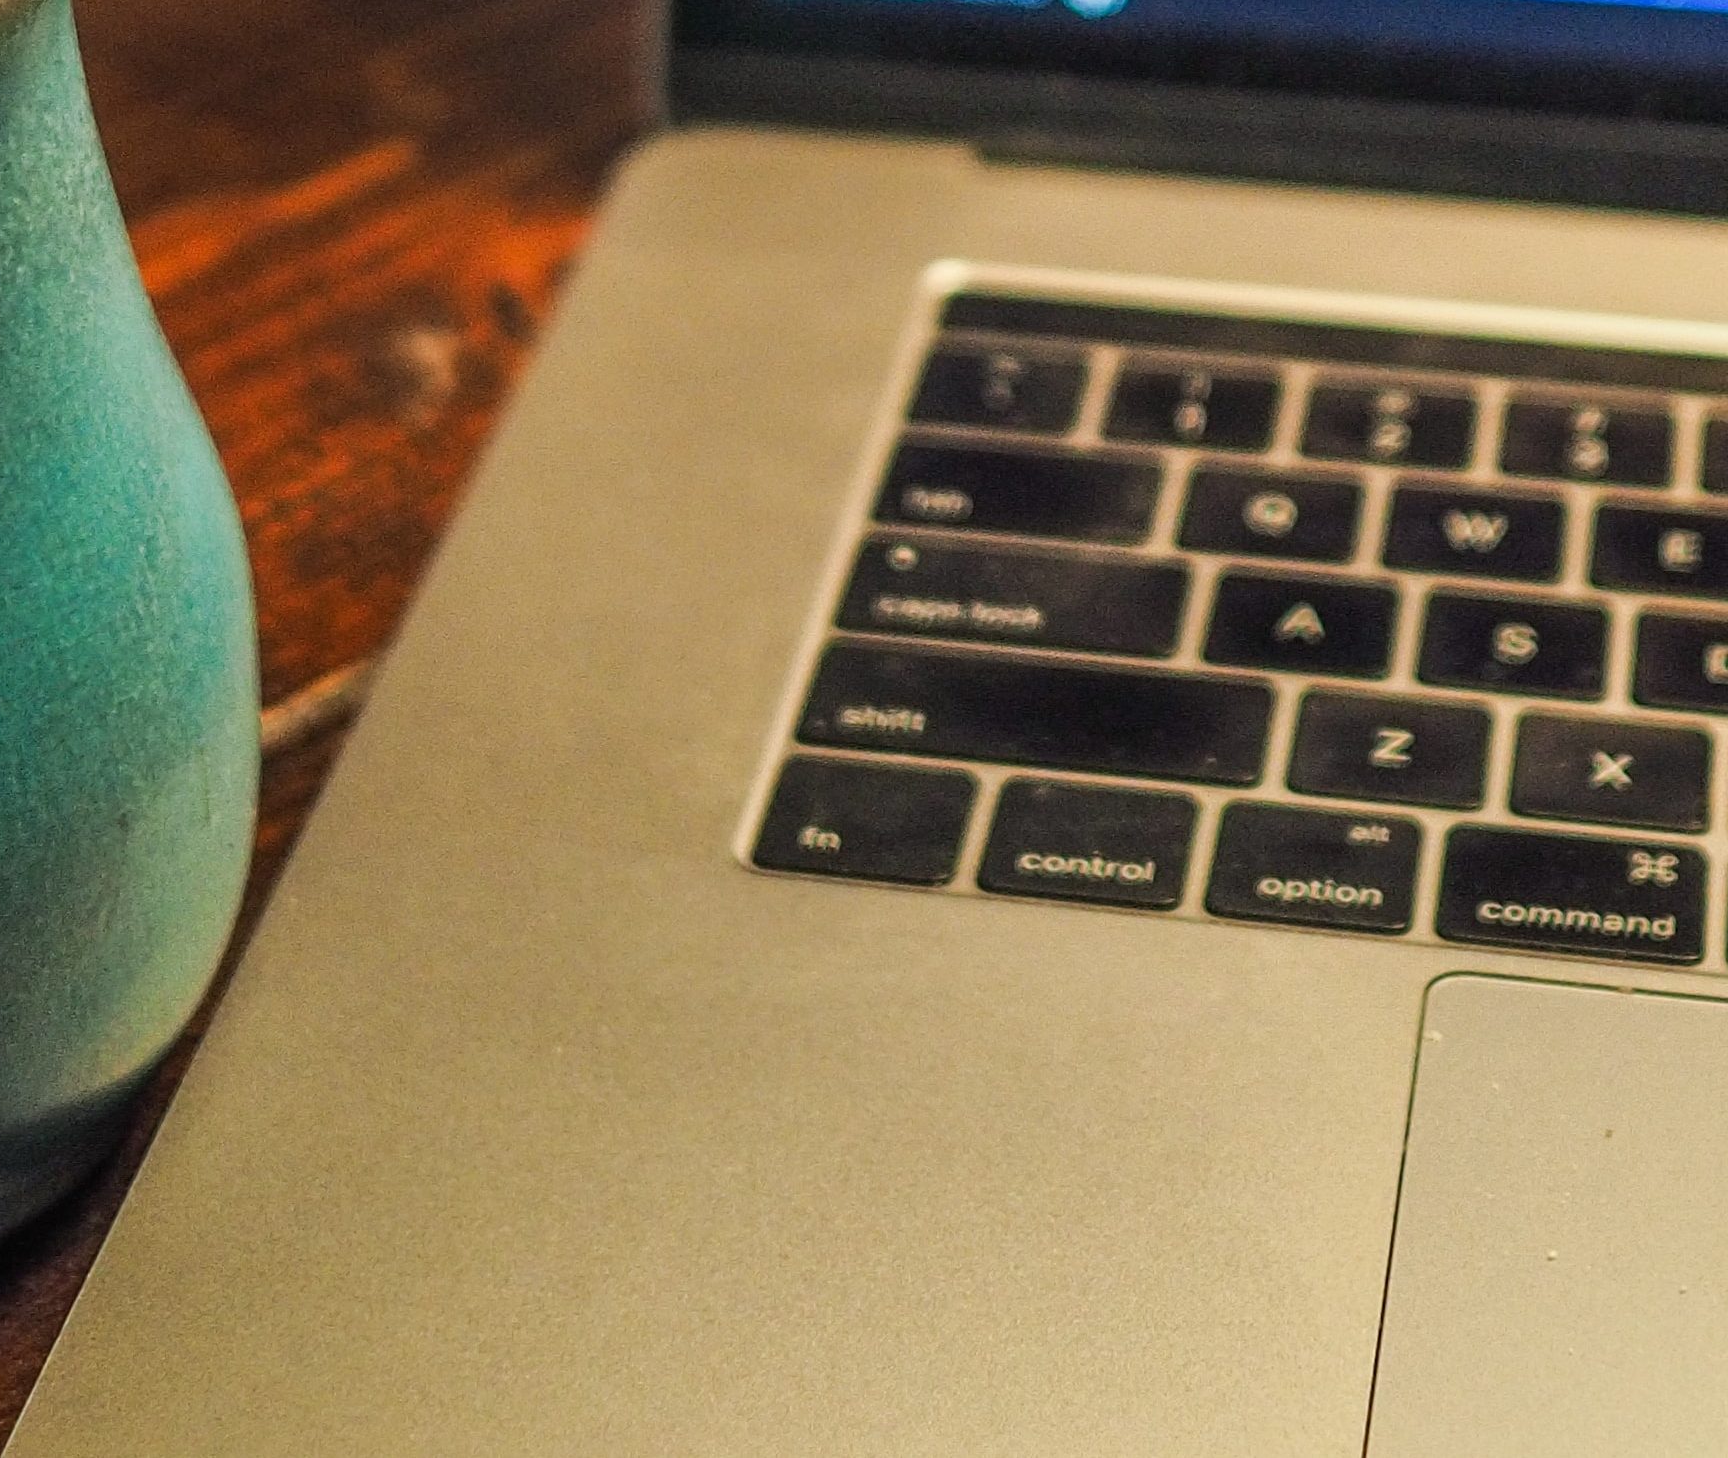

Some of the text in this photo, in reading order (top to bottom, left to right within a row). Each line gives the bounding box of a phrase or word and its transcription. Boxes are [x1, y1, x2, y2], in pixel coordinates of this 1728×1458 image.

[1246, 492, 1298, 532] Q
[1445, 511, 1506, 547] W
[1660, 530, 1699, 567] E
[1276, 603, 1326, 642] A
[1494, 622, 1539, 661] S
[839, 705, 927, 733] shift
[1370, 727, 1415, 765] Z
[1590, 749, 1634, 789] X
[799, 824, 842, 851] fn
[1348, 824, 1391, 843] alt
[1016, 851, 1156, 882] control
[1256, 876, 1384, 907] option
[1476, 900, 1677, 940] command
